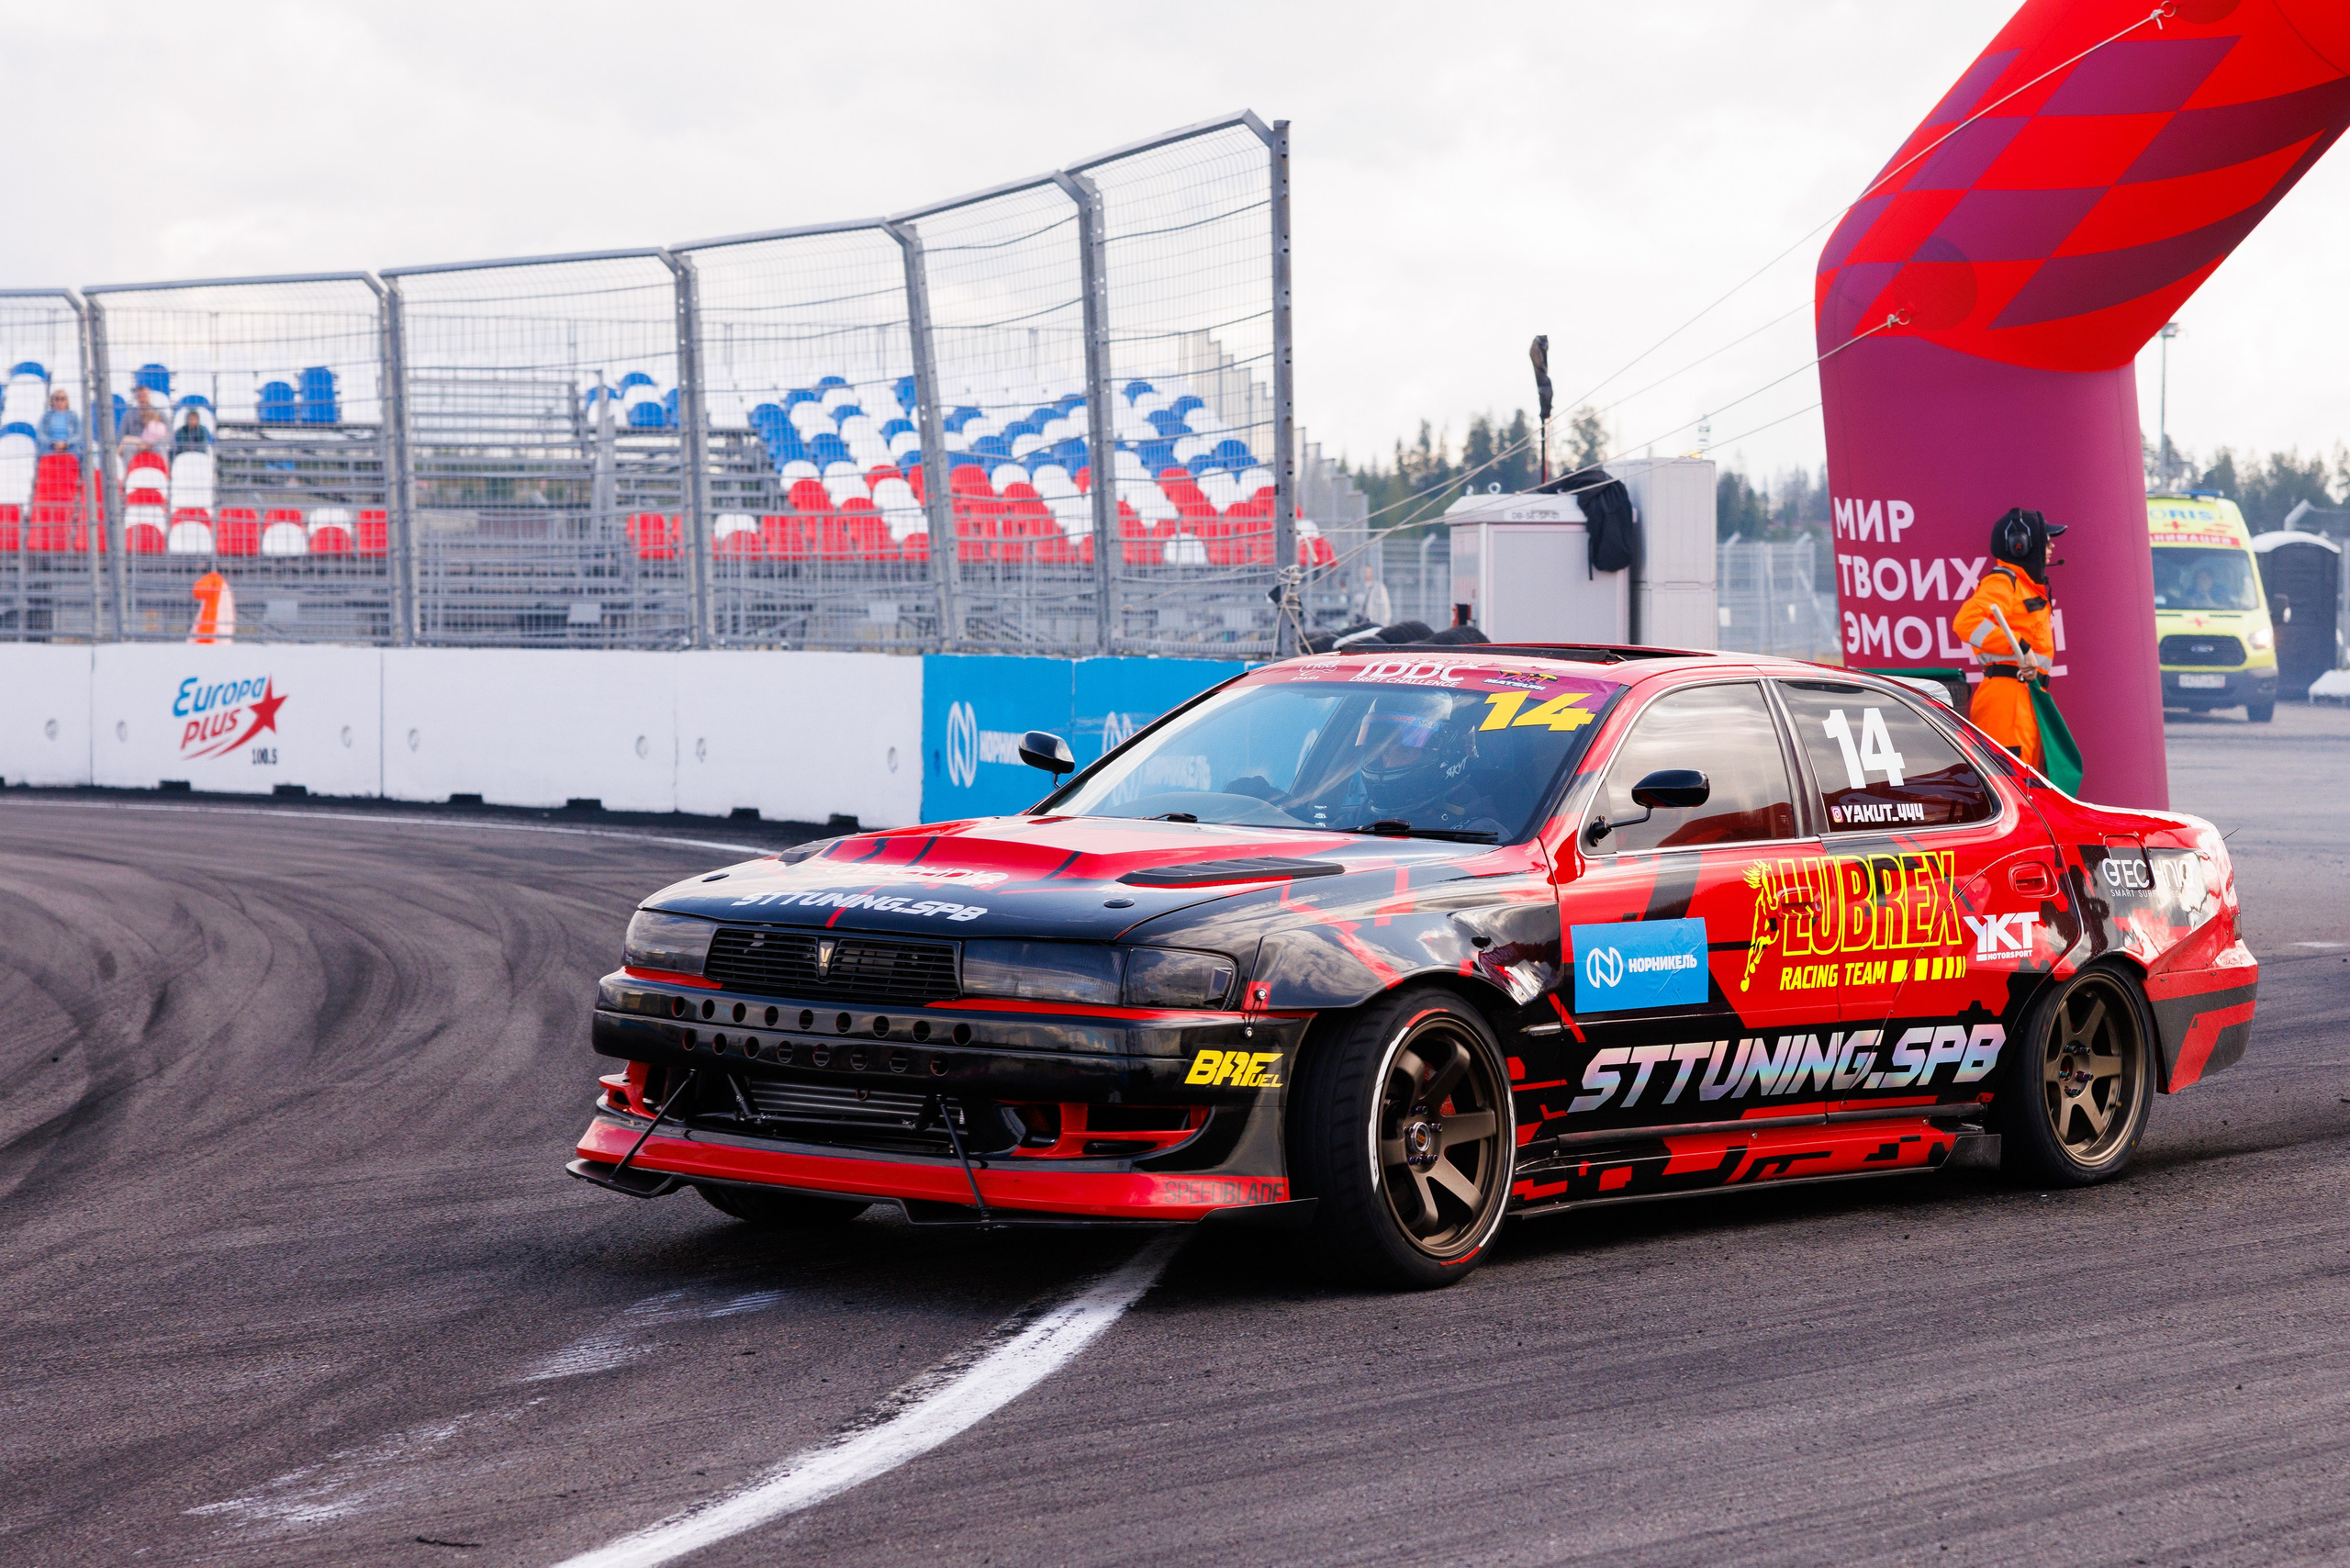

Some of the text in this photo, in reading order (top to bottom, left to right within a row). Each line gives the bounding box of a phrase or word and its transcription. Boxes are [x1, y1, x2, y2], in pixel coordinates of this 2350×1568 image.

[1834, 497, 1915, 543] МИР
[2149, 509, 2214, 521] ORIS
[1838, 554, 1987, 602] ТВОИХ
[1348, 675, 1460, 689] DRIFT CHALLENGE
[1355, 661, 1479, 682] IDDC
[1483, 678, 1548, 690] MATSURI
[172, 675, 266, 718] Europa
[1478, 690, 1596, 732] 14
[1821, 707, 1906, 790] 14
[731, 890, 989, 923] STTUNING.SPB
[1778, 851, 1963, 957] LUBREX
[2110, 889, 2136, 898] SMART
[1964, 911, 2040, 953] YKT
[1628, 953, 1698, 974] НОРНИКЕЛЬ
[1986, 949, 2033, 961] MOTORSPORT
[1779, 958, 1887, 991] RACING TEAM
[1568, 1023, 2007, 1114] STTUNING.SPB
